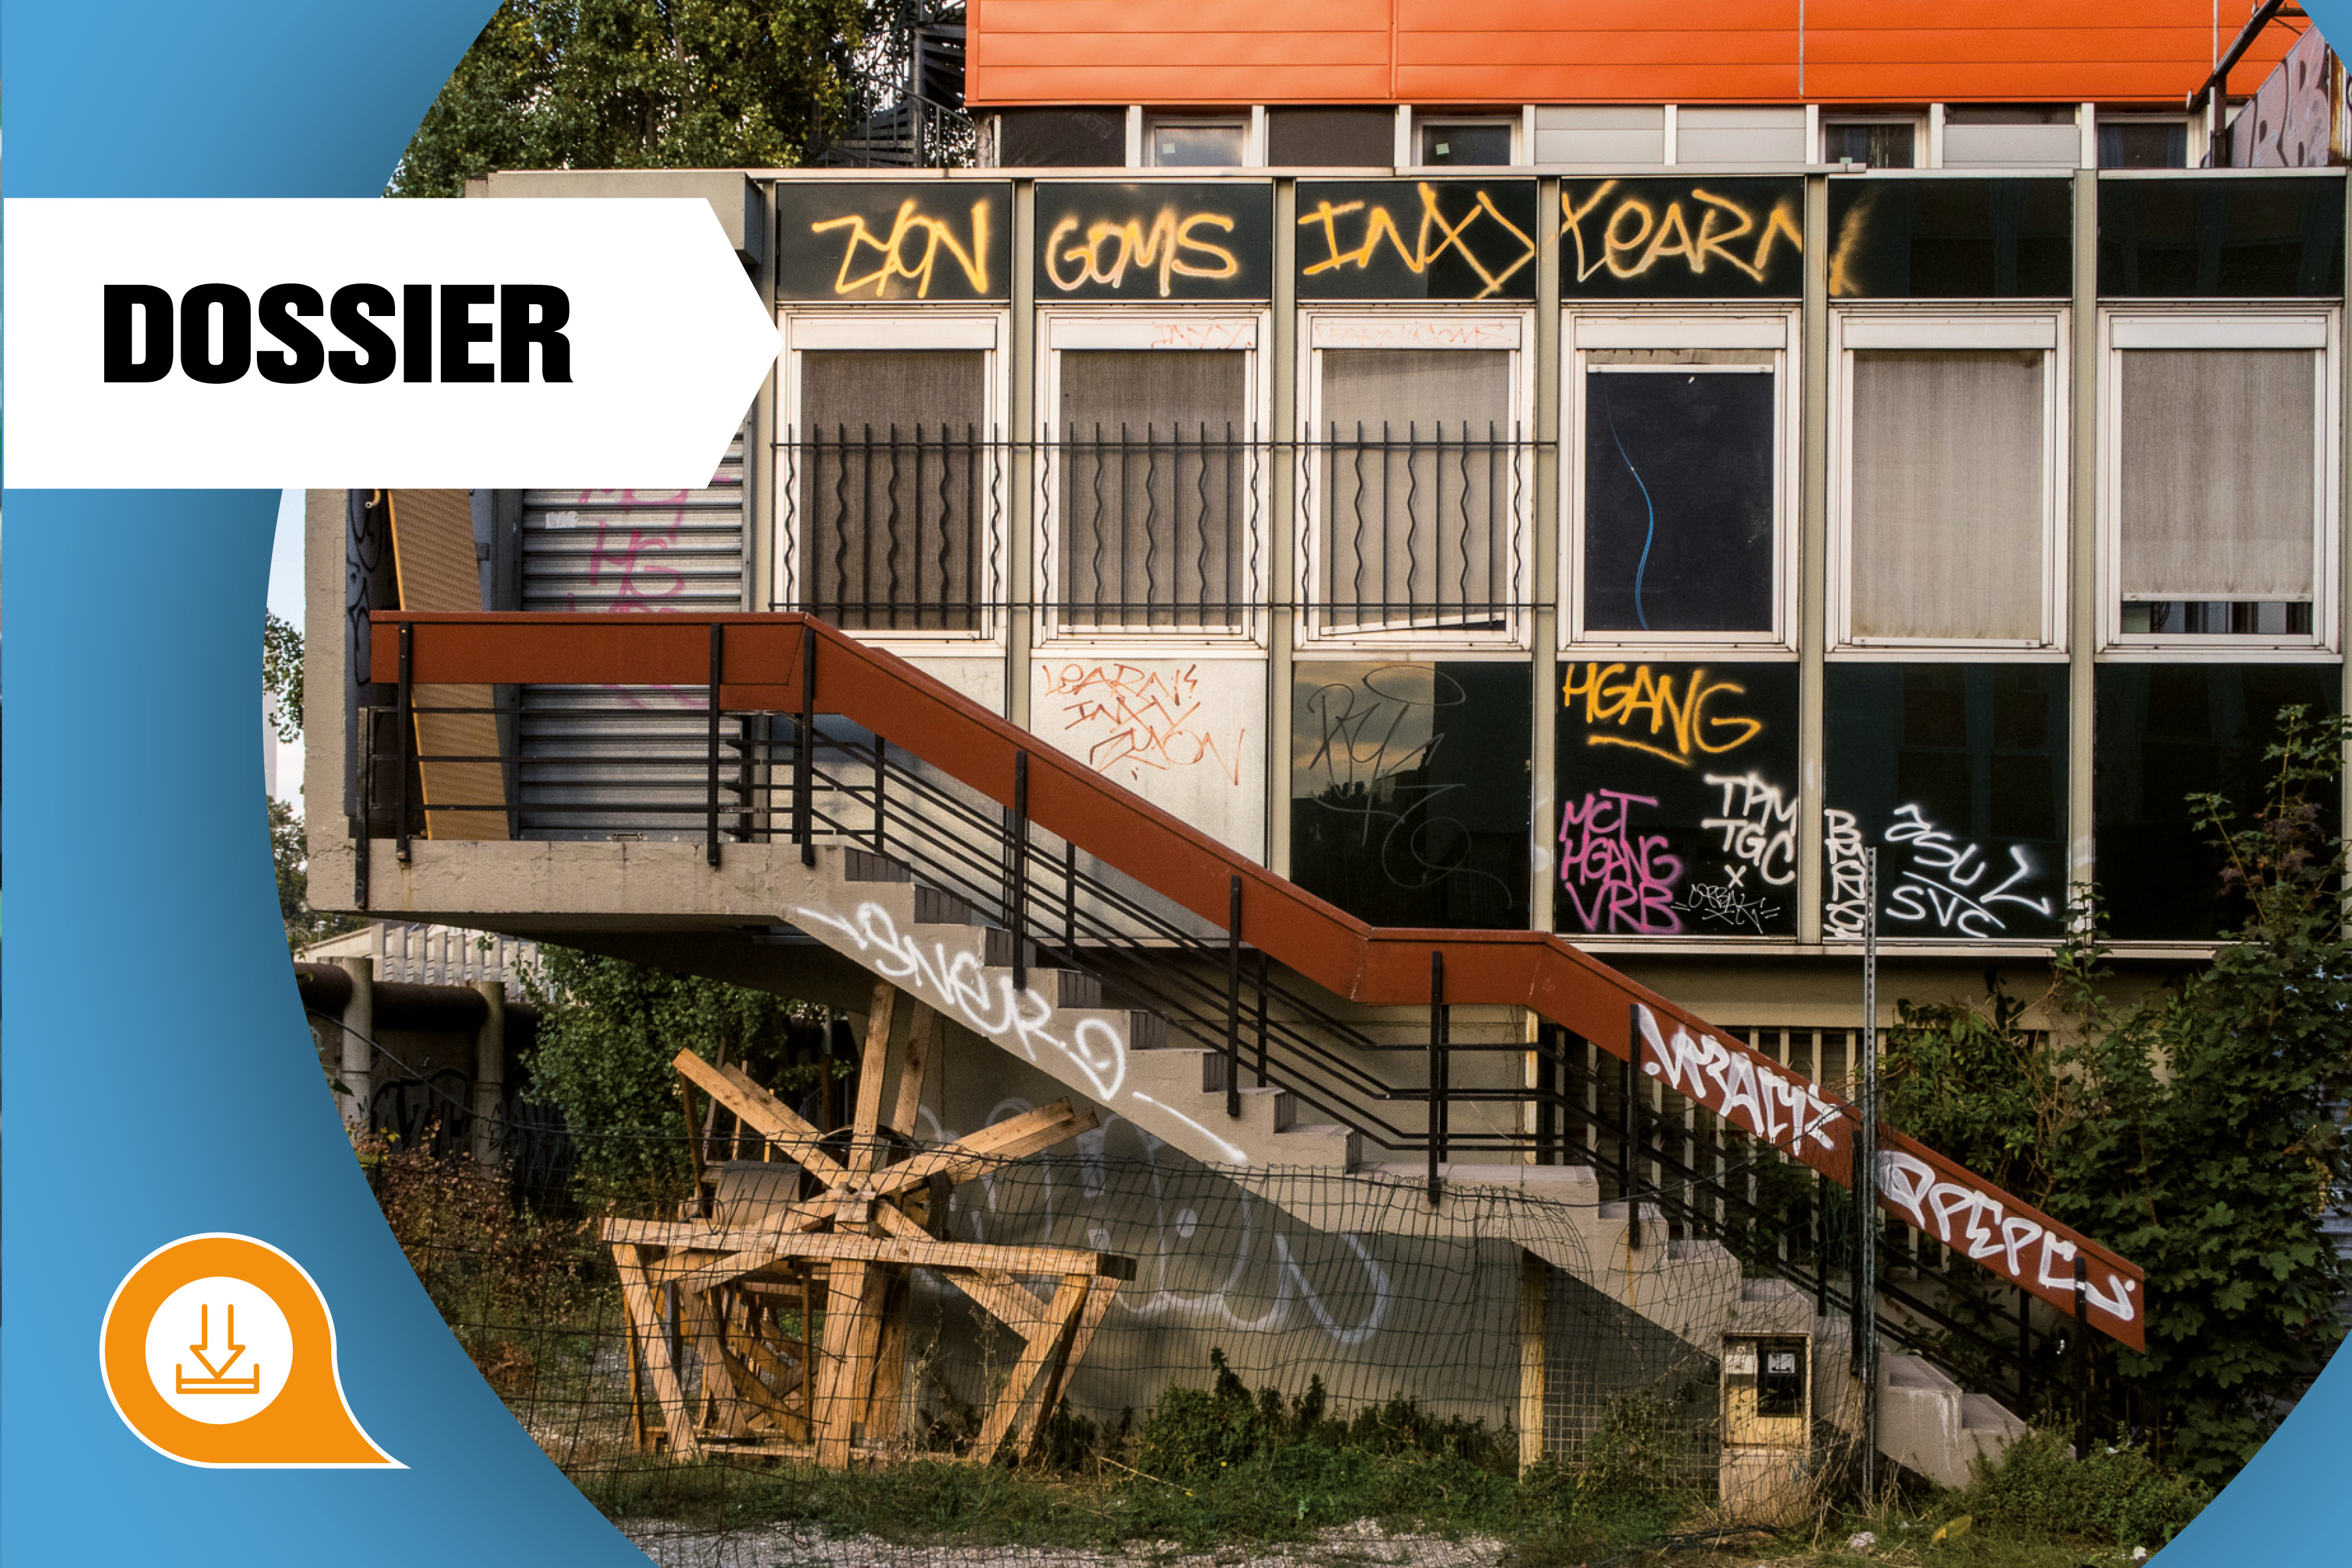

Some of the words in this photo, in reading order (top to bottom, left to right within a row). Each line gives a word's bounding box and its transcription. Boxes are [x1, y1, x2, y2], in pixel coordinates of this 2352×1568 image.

[1046, 204, 1238, 298] GOMS
[1563, 662, 1761, 755] HGANG
[1561, 787, 1659, 844] MCT
[1561, 834, 1684, 888] HGANG
[1700, 819, 1797, 886] TGC
[1563, 879, 1685, 935] VRB
